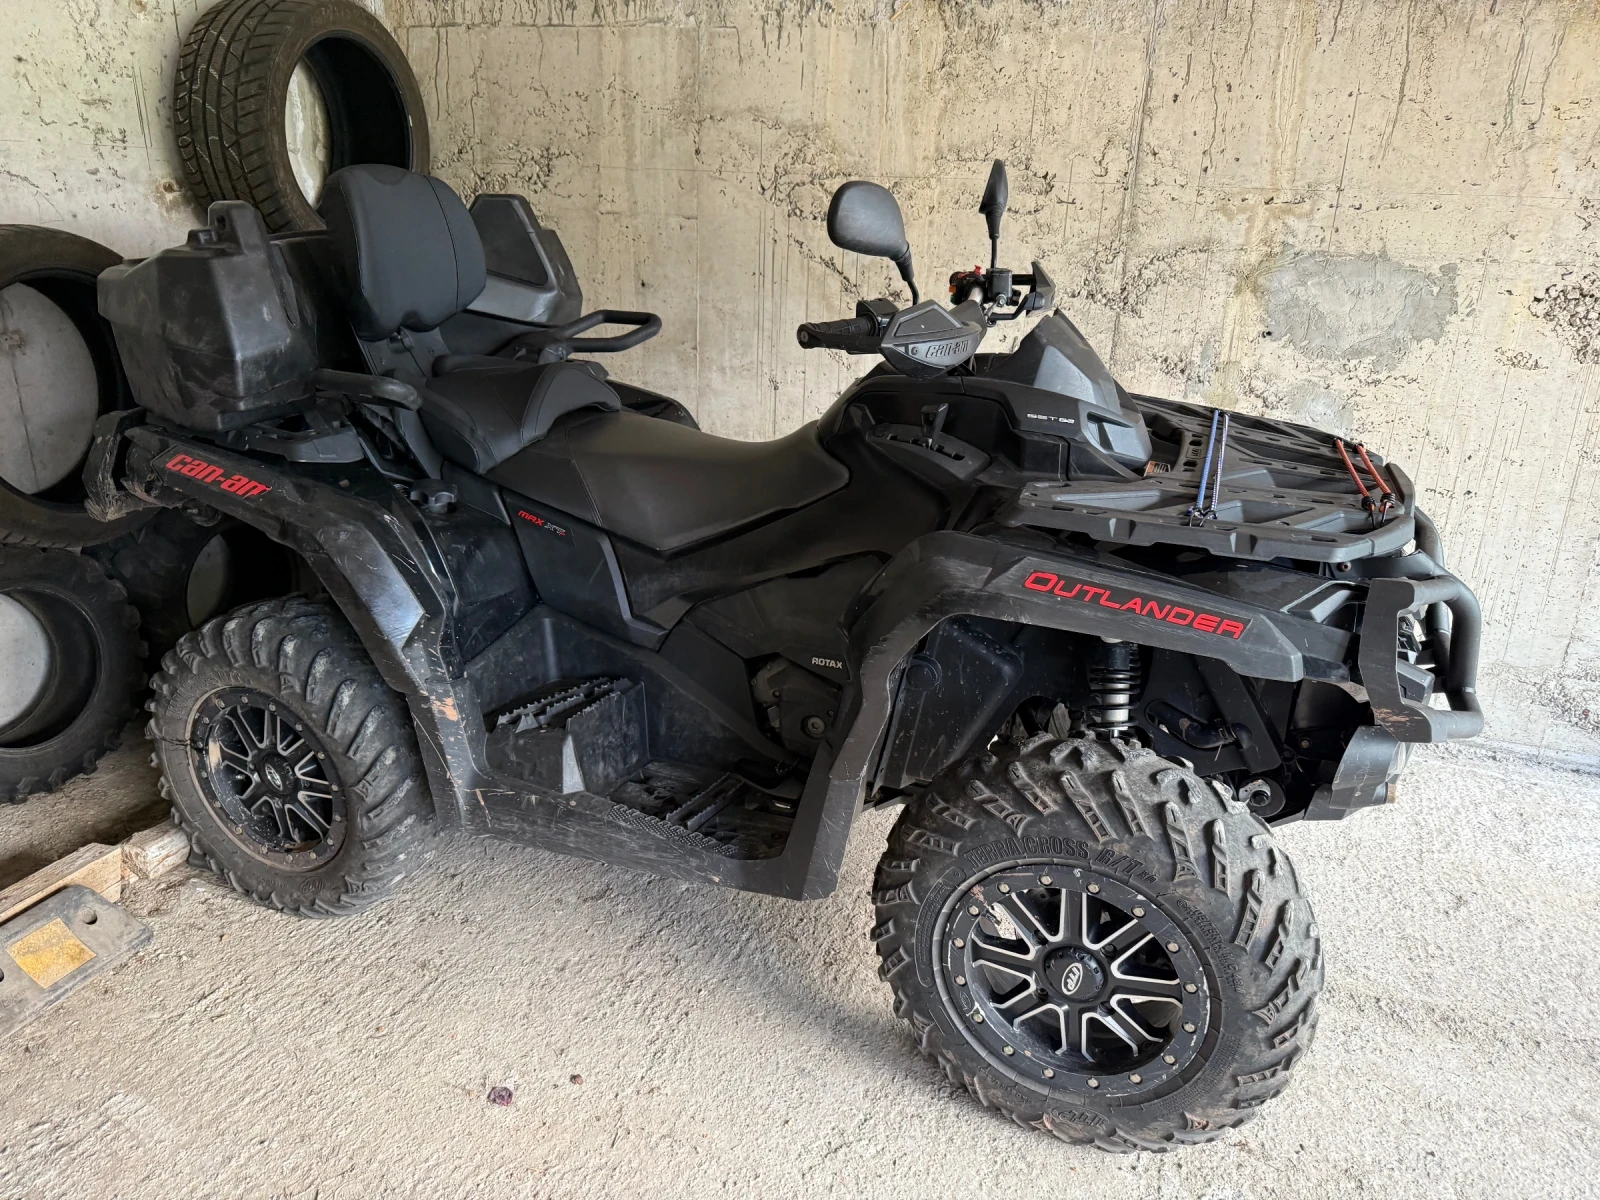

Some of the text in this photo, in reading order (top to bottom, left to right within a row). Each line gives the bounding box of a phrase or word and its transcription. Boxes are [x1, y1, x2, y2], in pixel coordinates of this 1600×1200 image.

[517, 510, 545, 527] MAX
[1024, 571, 1245, 639] OUTLANDER
[811, 656, 843, 669] ROTAX
